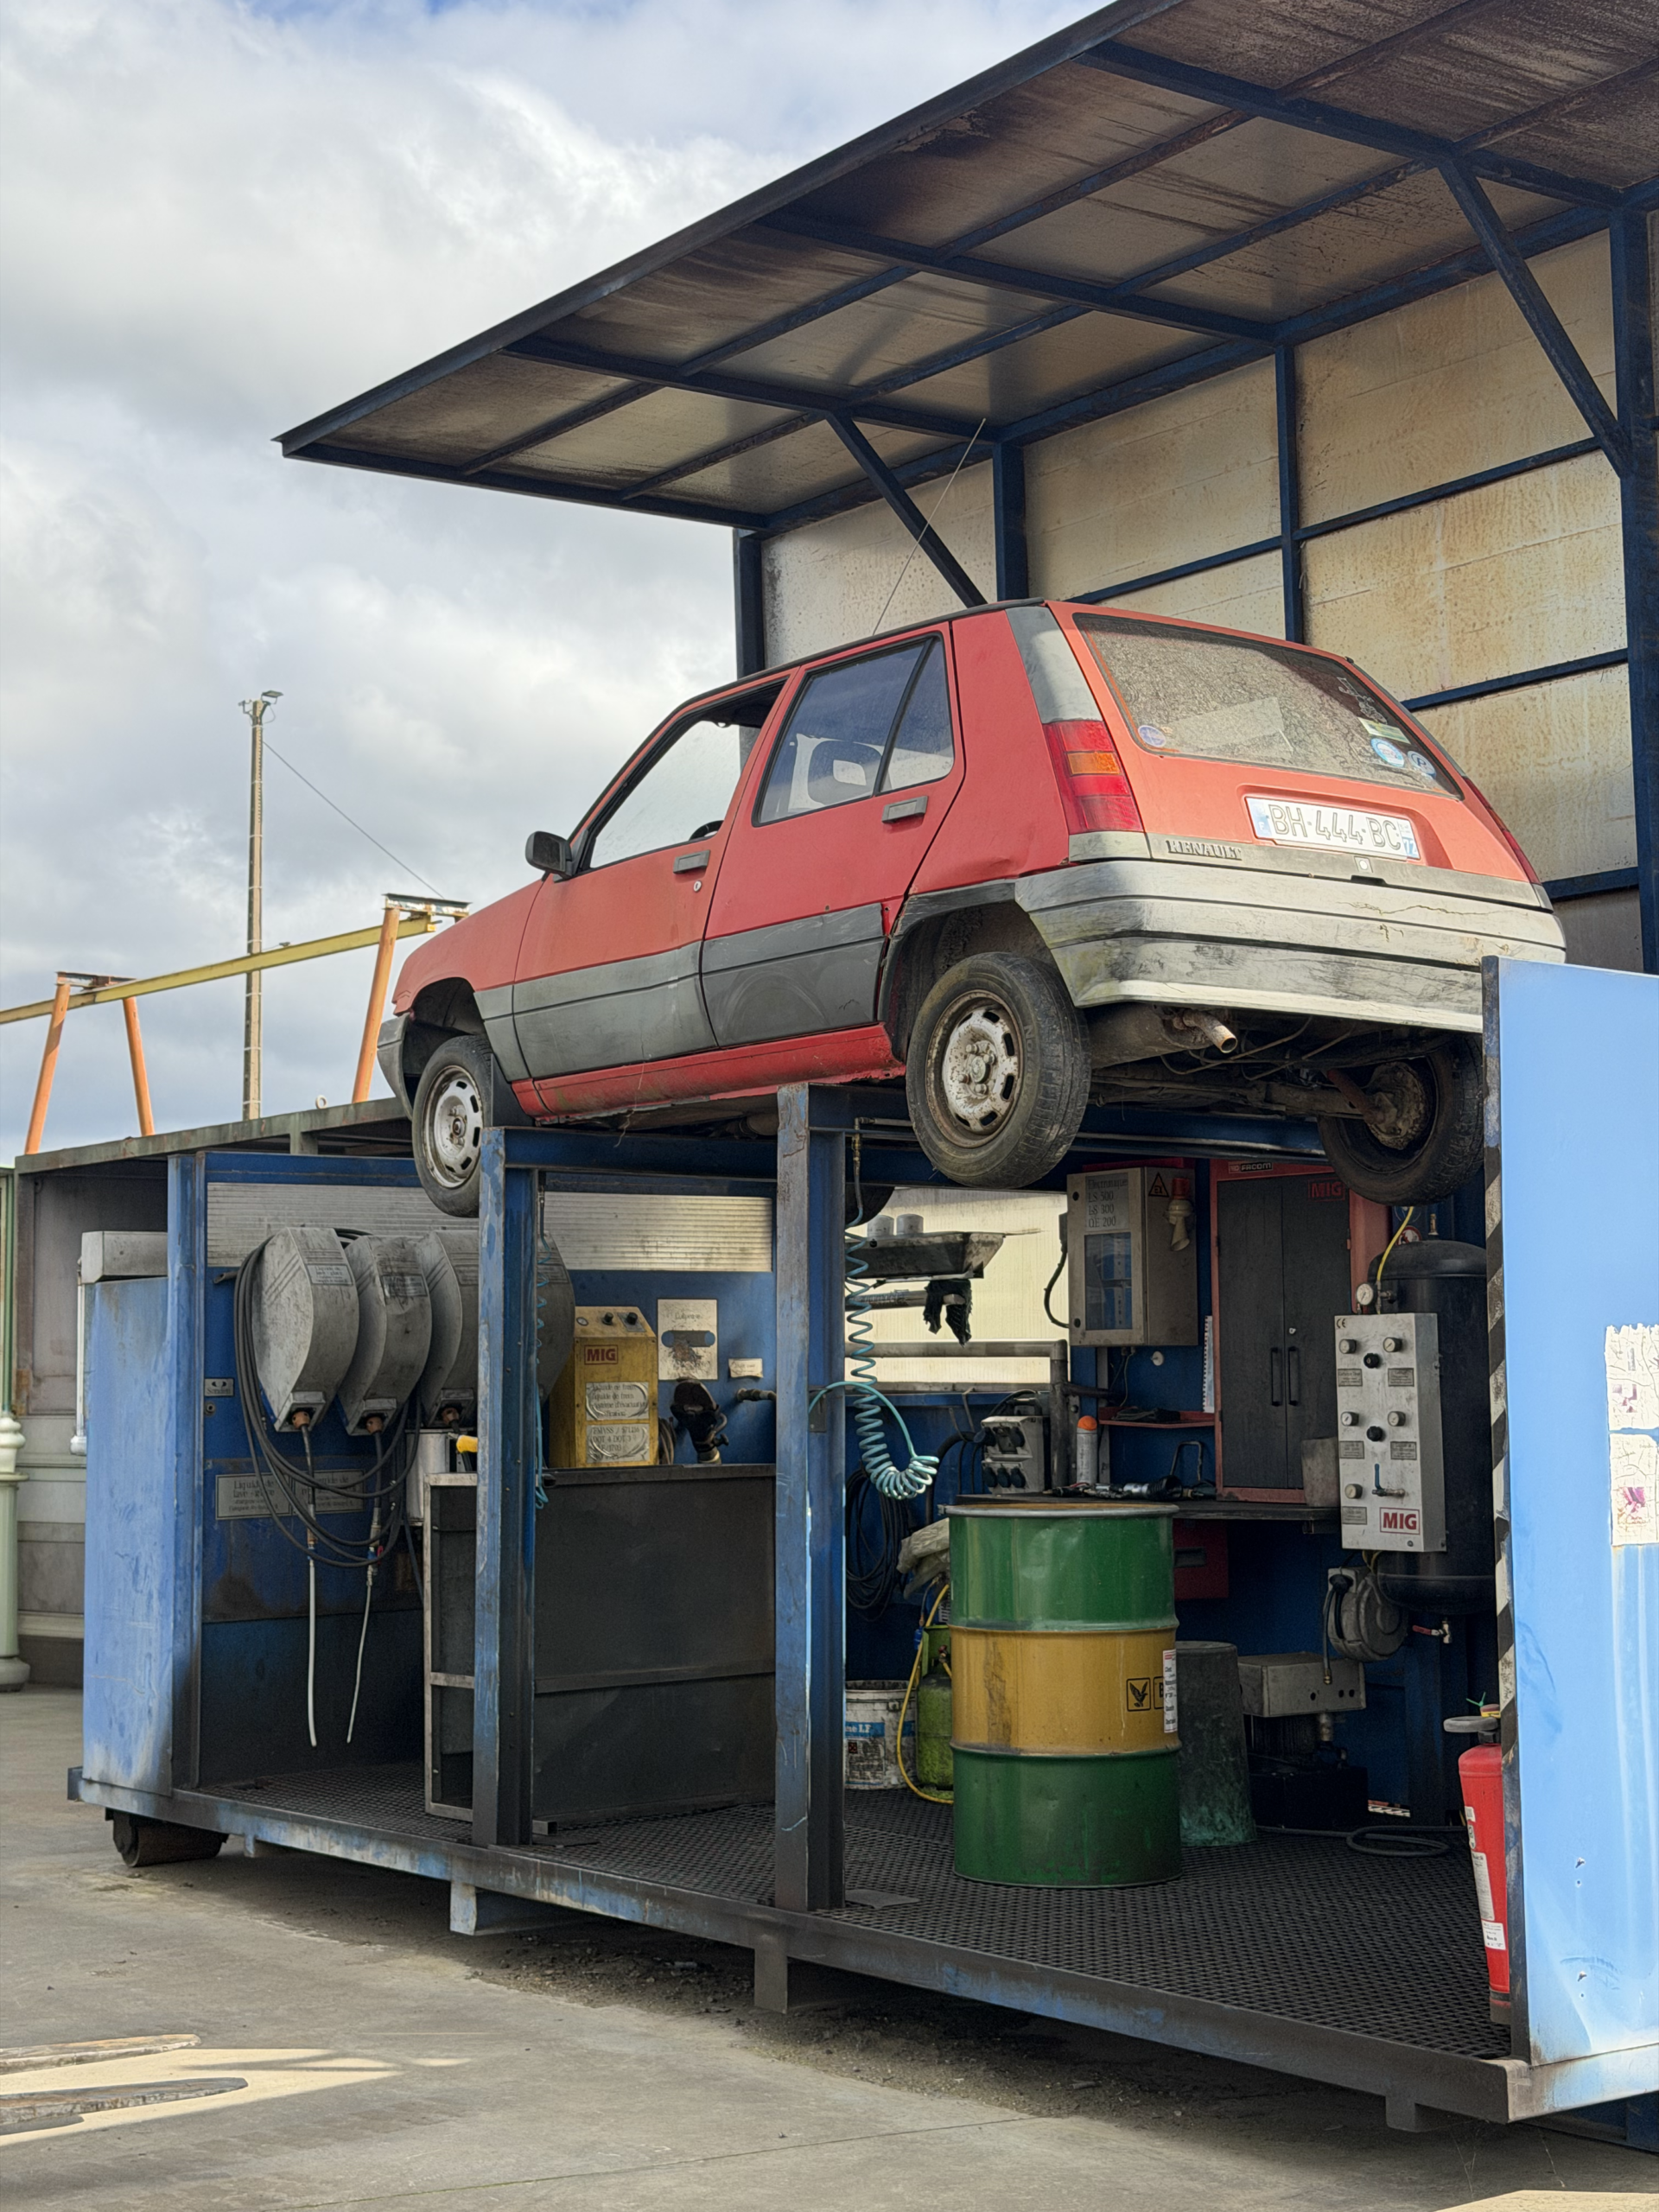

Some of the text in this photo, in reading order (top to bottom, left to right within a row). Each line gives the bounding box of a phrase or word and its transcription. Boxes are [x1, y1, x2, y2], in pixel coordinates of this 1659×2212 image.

[1165, 839, 1243, 861] RENAULT
[1241, 1162, 1271, 1172] FACOM
[1311, 1181, 1342, 1198] MIG
[587, 1348, 616, 1362] MIG
[1382, 1511, 1418, 1530] MIG
